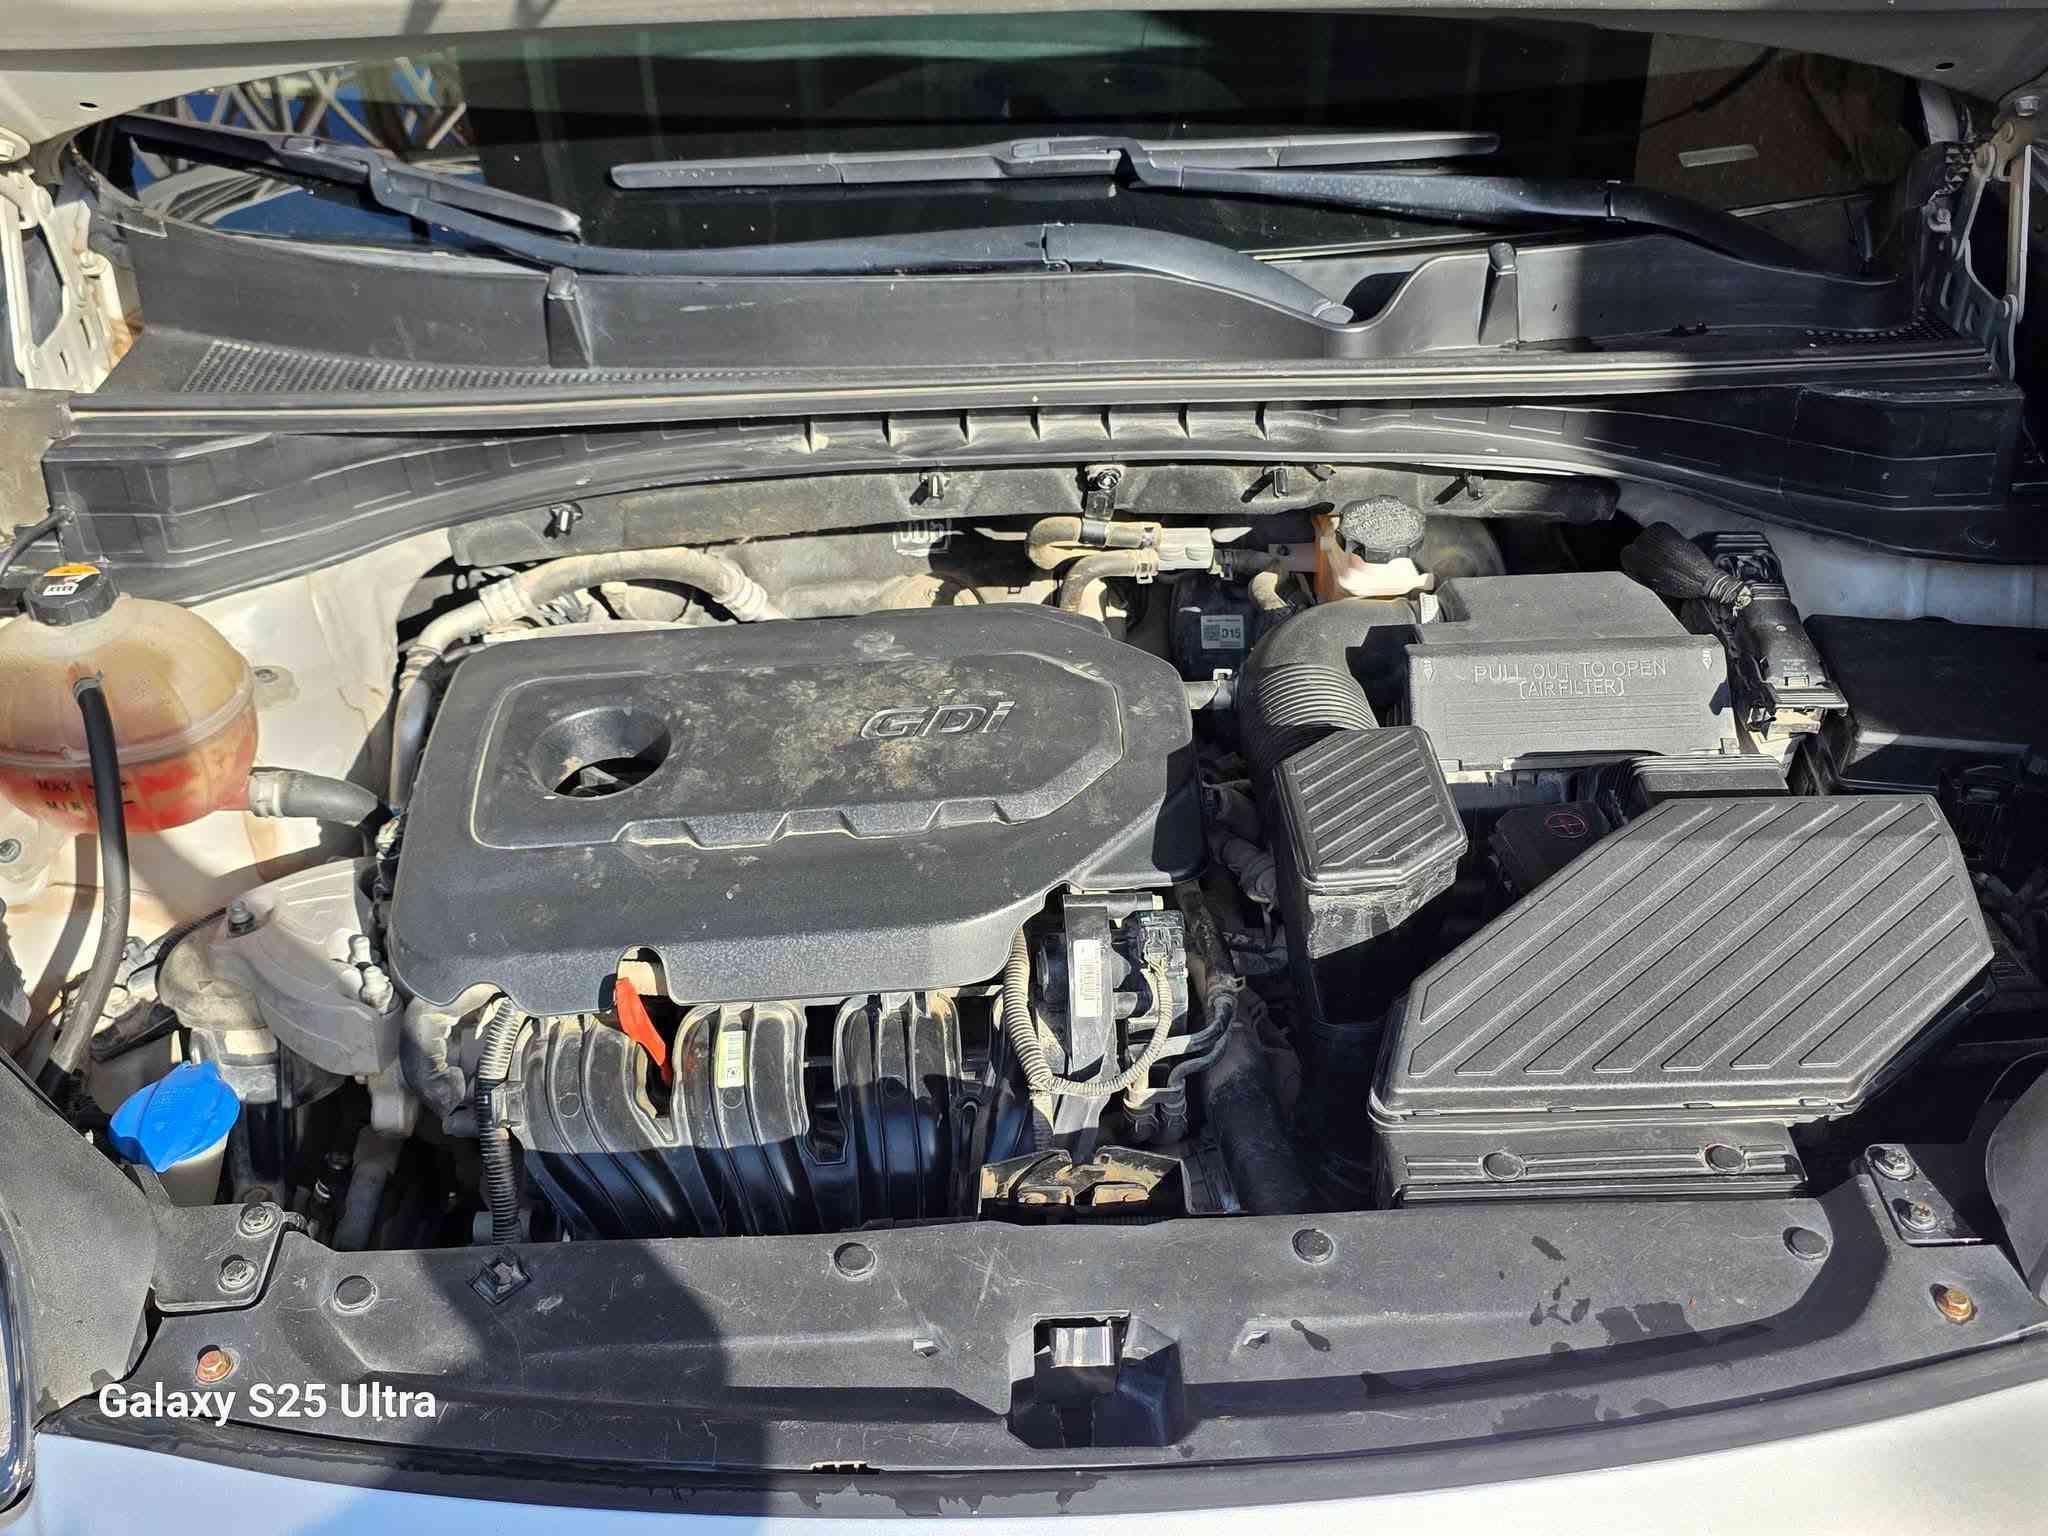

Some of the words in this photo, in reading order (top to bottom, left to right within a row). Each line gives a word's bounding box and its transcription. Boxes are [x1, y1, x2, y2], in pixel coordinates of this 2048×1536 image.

[1474, 663, 1525, 681] PULL
[1533, 663, 1570, 679] OUT
[1579, 661, 1606, 677] TO
[1612, 659, 1667, 677] OPEN
